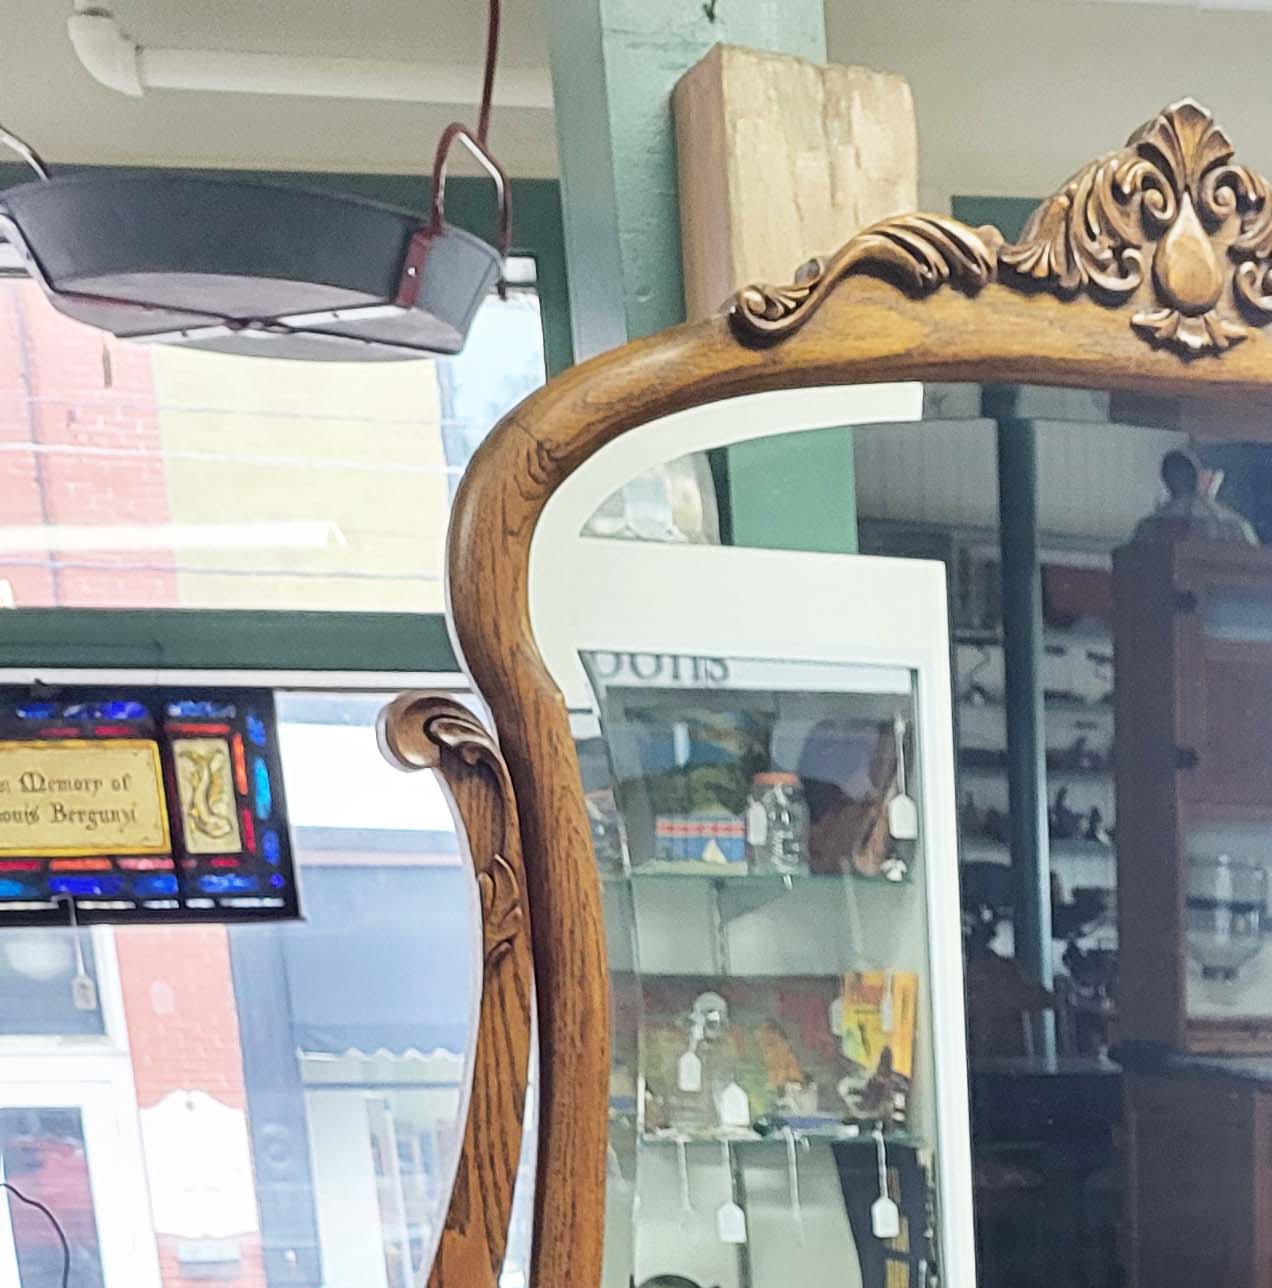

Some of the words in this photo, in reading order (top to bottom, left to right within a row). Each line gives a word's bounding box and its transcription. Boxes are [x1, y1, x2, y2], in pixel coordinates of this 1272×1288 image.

[20, 771, 103, 799] Memory
[111, 772, 131, 792] of
[0, 802, 41, 825] ouis
